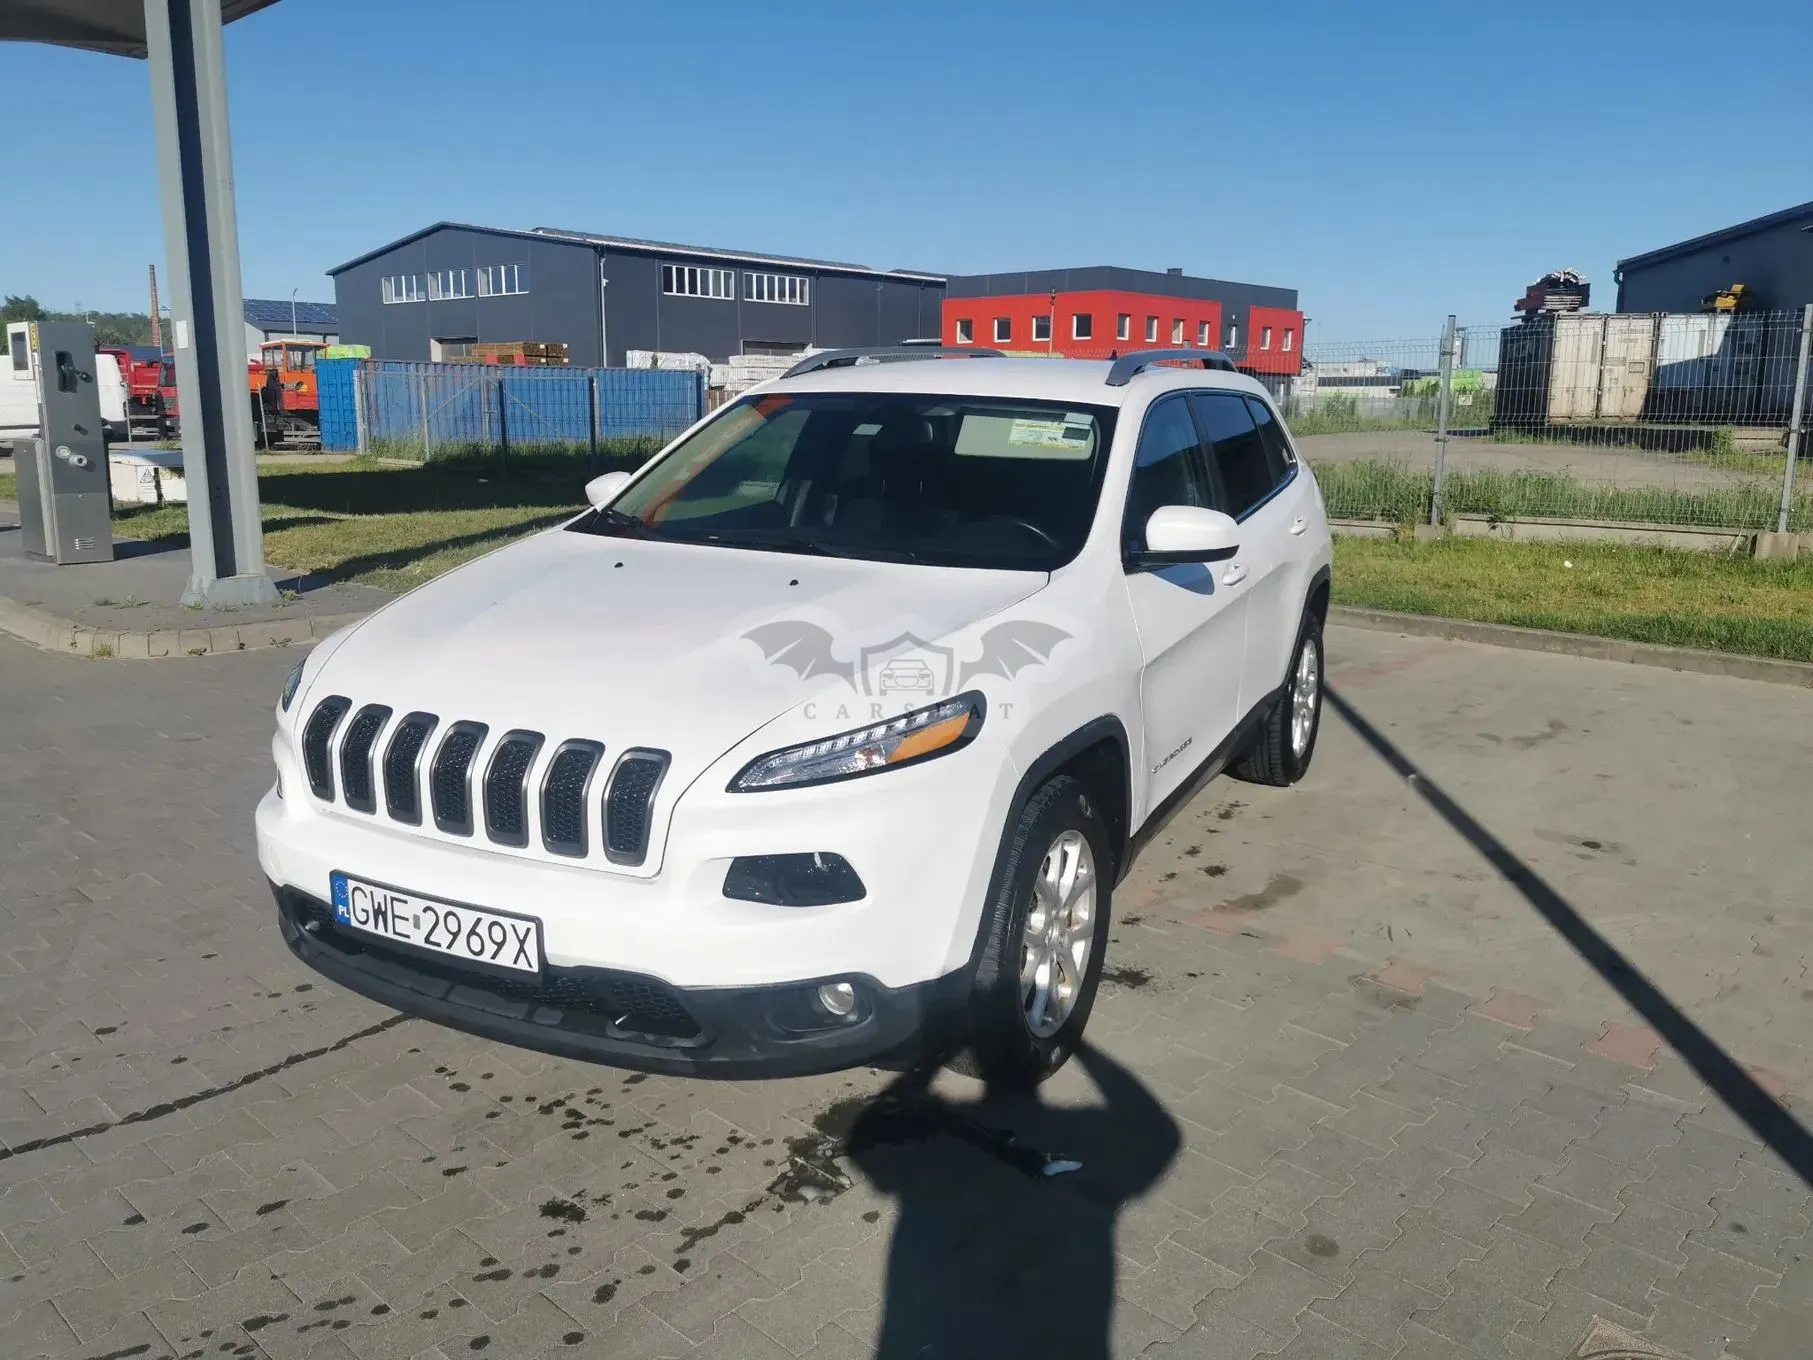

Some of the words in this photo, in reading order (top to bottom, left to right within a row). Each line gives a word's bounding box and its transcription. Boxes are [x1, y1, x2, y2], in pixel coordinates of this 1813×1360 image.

[338, 904, 350, 918] PL
[351, 886, 411, 939] GWE
[422, 905, 534, 968] 2969X
